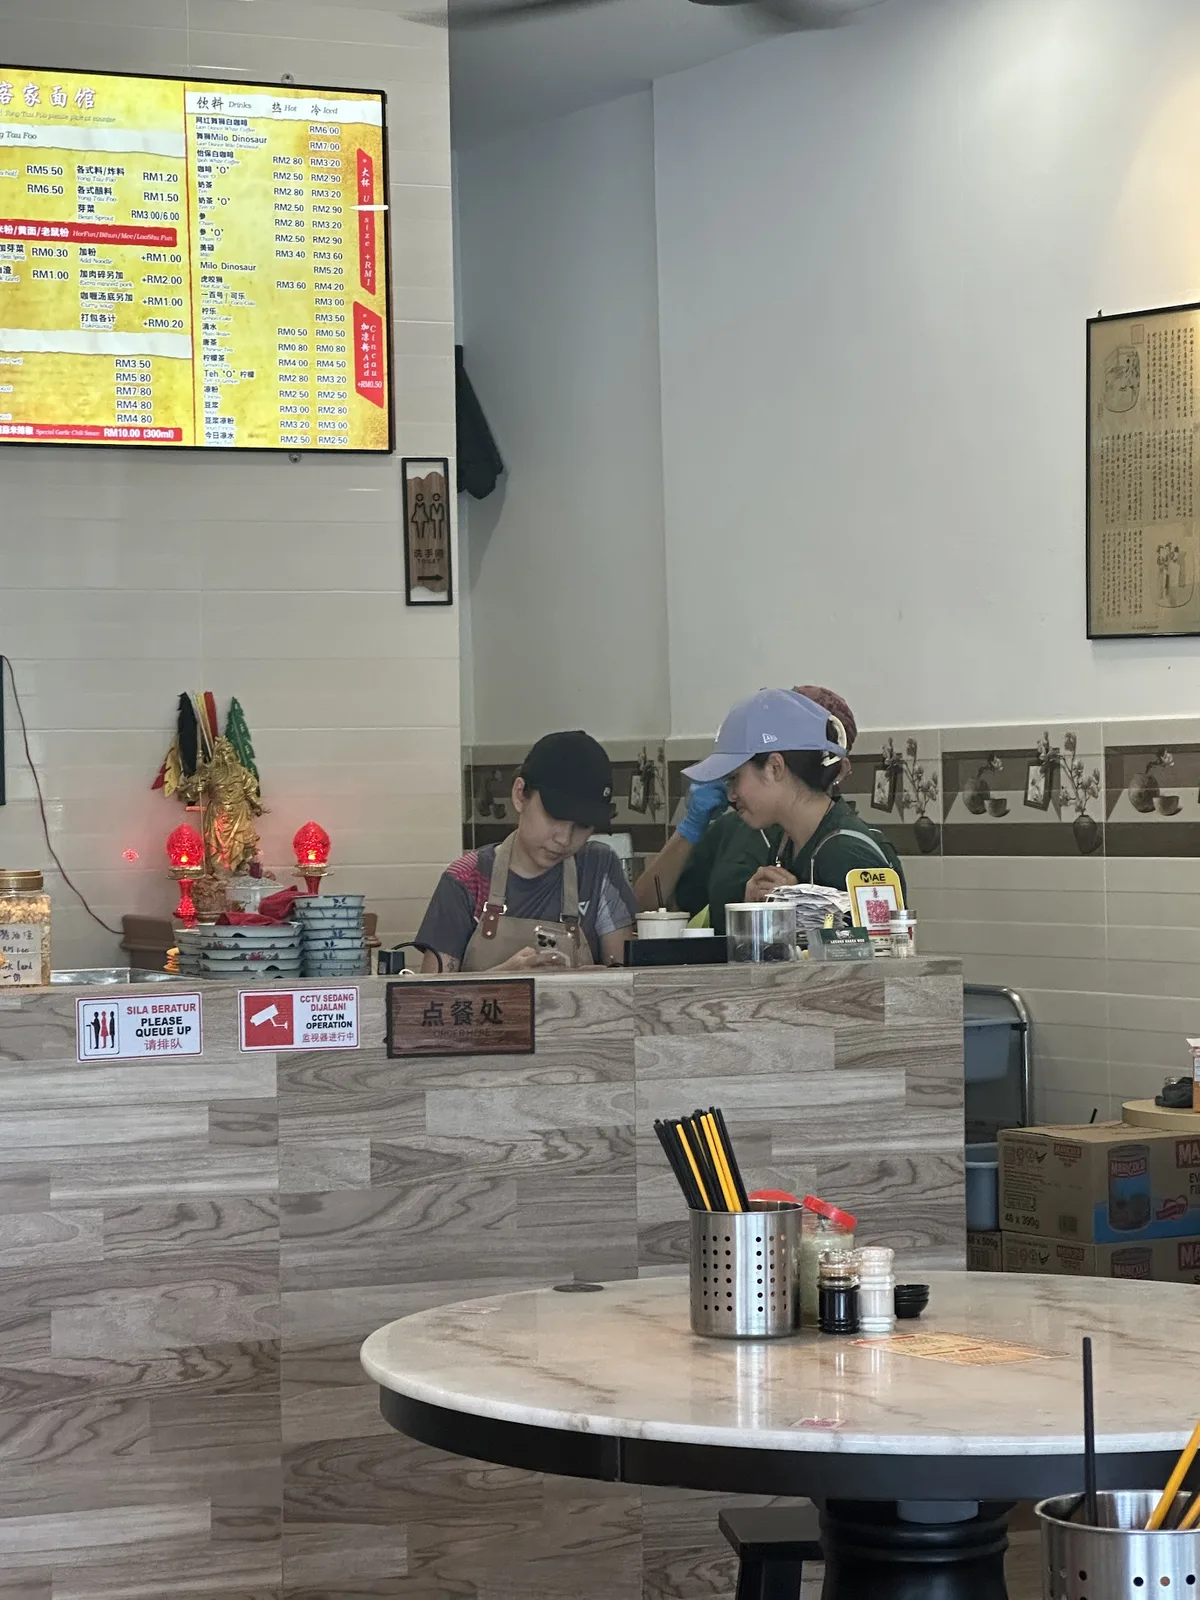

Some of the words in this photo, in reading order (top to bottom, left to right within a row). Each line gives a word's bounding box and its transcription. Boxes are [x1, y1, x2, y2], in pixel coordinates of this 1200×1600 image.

[196, 96, 224, 111] 饮料
[228, 101, 252, 109] Drinks
[272, 102, 282, 113] 热
[284, 104, 297, 112] Hot
[311, 104, 321, 116] 冷
[6, 131, 21, 139] Tau
[23, 132, 37, 140] Foo
[232, 135, 267, 143] Dinosaur
[26, 165, 63, 176] RM5.50
[143, 172, 178, 182] RM1.20
[27, 184, 64, 194] RM6.50
[198, 181, 212, 189] 奶茶
[143, 192, 179, 202] RM1.50
[78, 204, 95, 213] 芽菜
[131, 210, 179, 221] RM3.00/6.00
[31, 247, 68, 257] RM0.30
[79, 247, 96, 257] 加粉
[141, 253, 182, 263] +RM1.00
[221, 262, 256, 271] Dinosaur
[32, 270, 69, 280] RM1.00
[142, 275, 182, 285] +RM2.00
[142, 297, 183, 307] +RM1.00
[143, 319, 183, 328] +RM0.20
[104, 428, 140, 438] RM10.00
[143, 429, 174, 439] (300ml)
[860, 871, 886, 883] MAE
[300, 995, 321, 1003] CCTV
[323, 993, 354, 1002] SEDANG
[126, 1005, 149, 1015] SILA
[151, 1003, 196, 1014] BERATUR
[310, 1003, 346, 1012] DIJALANI
[311, 1014, 334, 1022] CCTV
[336, 1013, 345, 1021] IN
[421, 999, 503, 1027] 点餐处
[141, 1016, 183, 1027] PLEASE
[305, 1021, 353, 1030] OPERATION
[135, 1027, 173, 1038] QUEUE
[177, 1026, 192, 1035] UP
[144, 1038, 183, 1051] 请排队
